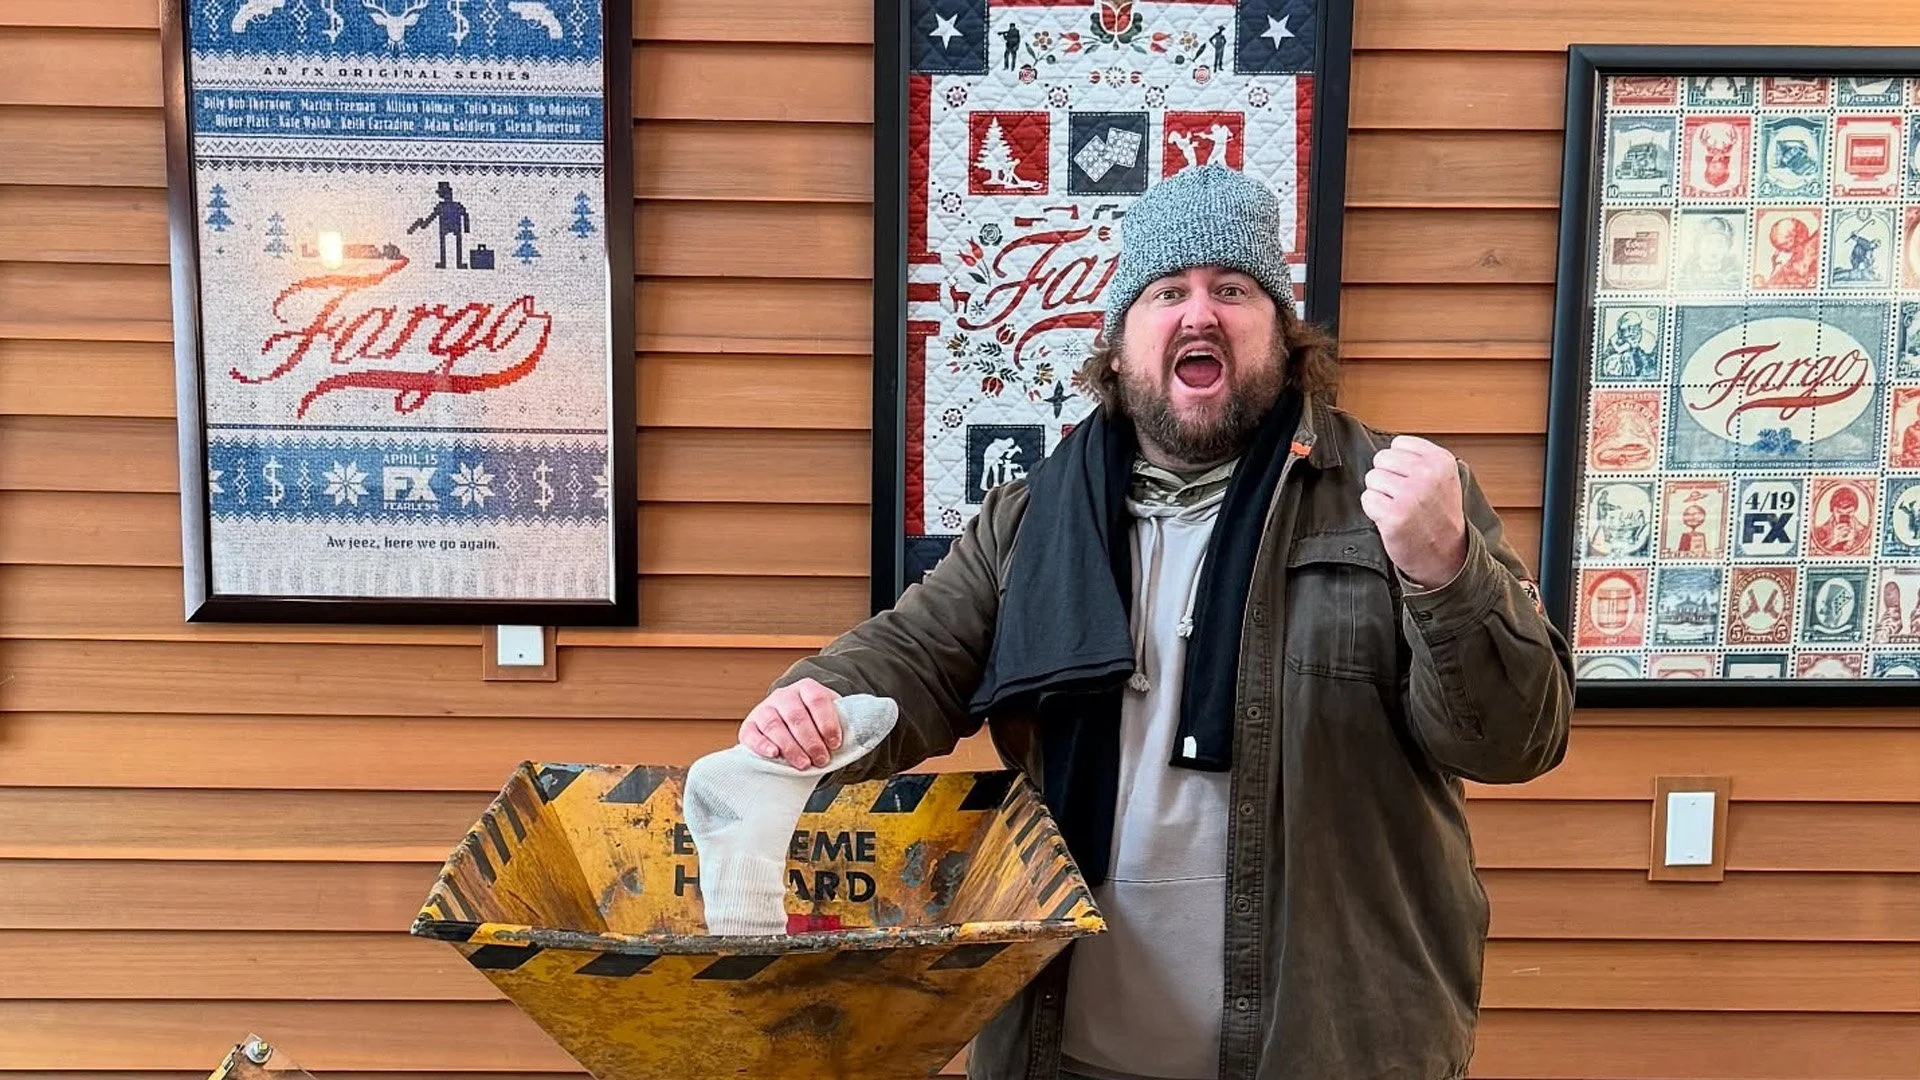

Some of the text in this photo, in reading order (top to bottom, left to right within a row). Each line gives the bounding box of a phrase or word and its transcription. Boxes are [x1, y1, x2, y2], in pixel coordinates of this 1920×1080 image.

[264, 67, 531, 81] AN FX ORIGINAL SERIES
[204, 96, 590, 118] Billy Bob Thornton Martin Freeman Allison Tolman Colin Hanks Bob Odenkirk
[215, 114, 581, 134] Oliver Platt Kate Walsh Keith Carradine Adam Goldberg Glenn Howerton
[956, 224, 1122, 372] Far
[229, 256, 552, 419] Fargo
[1689, 342, 1868, 436] Fargo
[383, 453, 438, 465] APRIL 15
[383, 466, 440, 501] FX
[1745, 491, 1796, 513] 4/19
[326, 535, 500, 551] Aw jeez, here we go again.
[1742, 513, 1794, 544] FX
[673, 822, 877, 863] EEME
[674, 864, 877, 903] HARD
